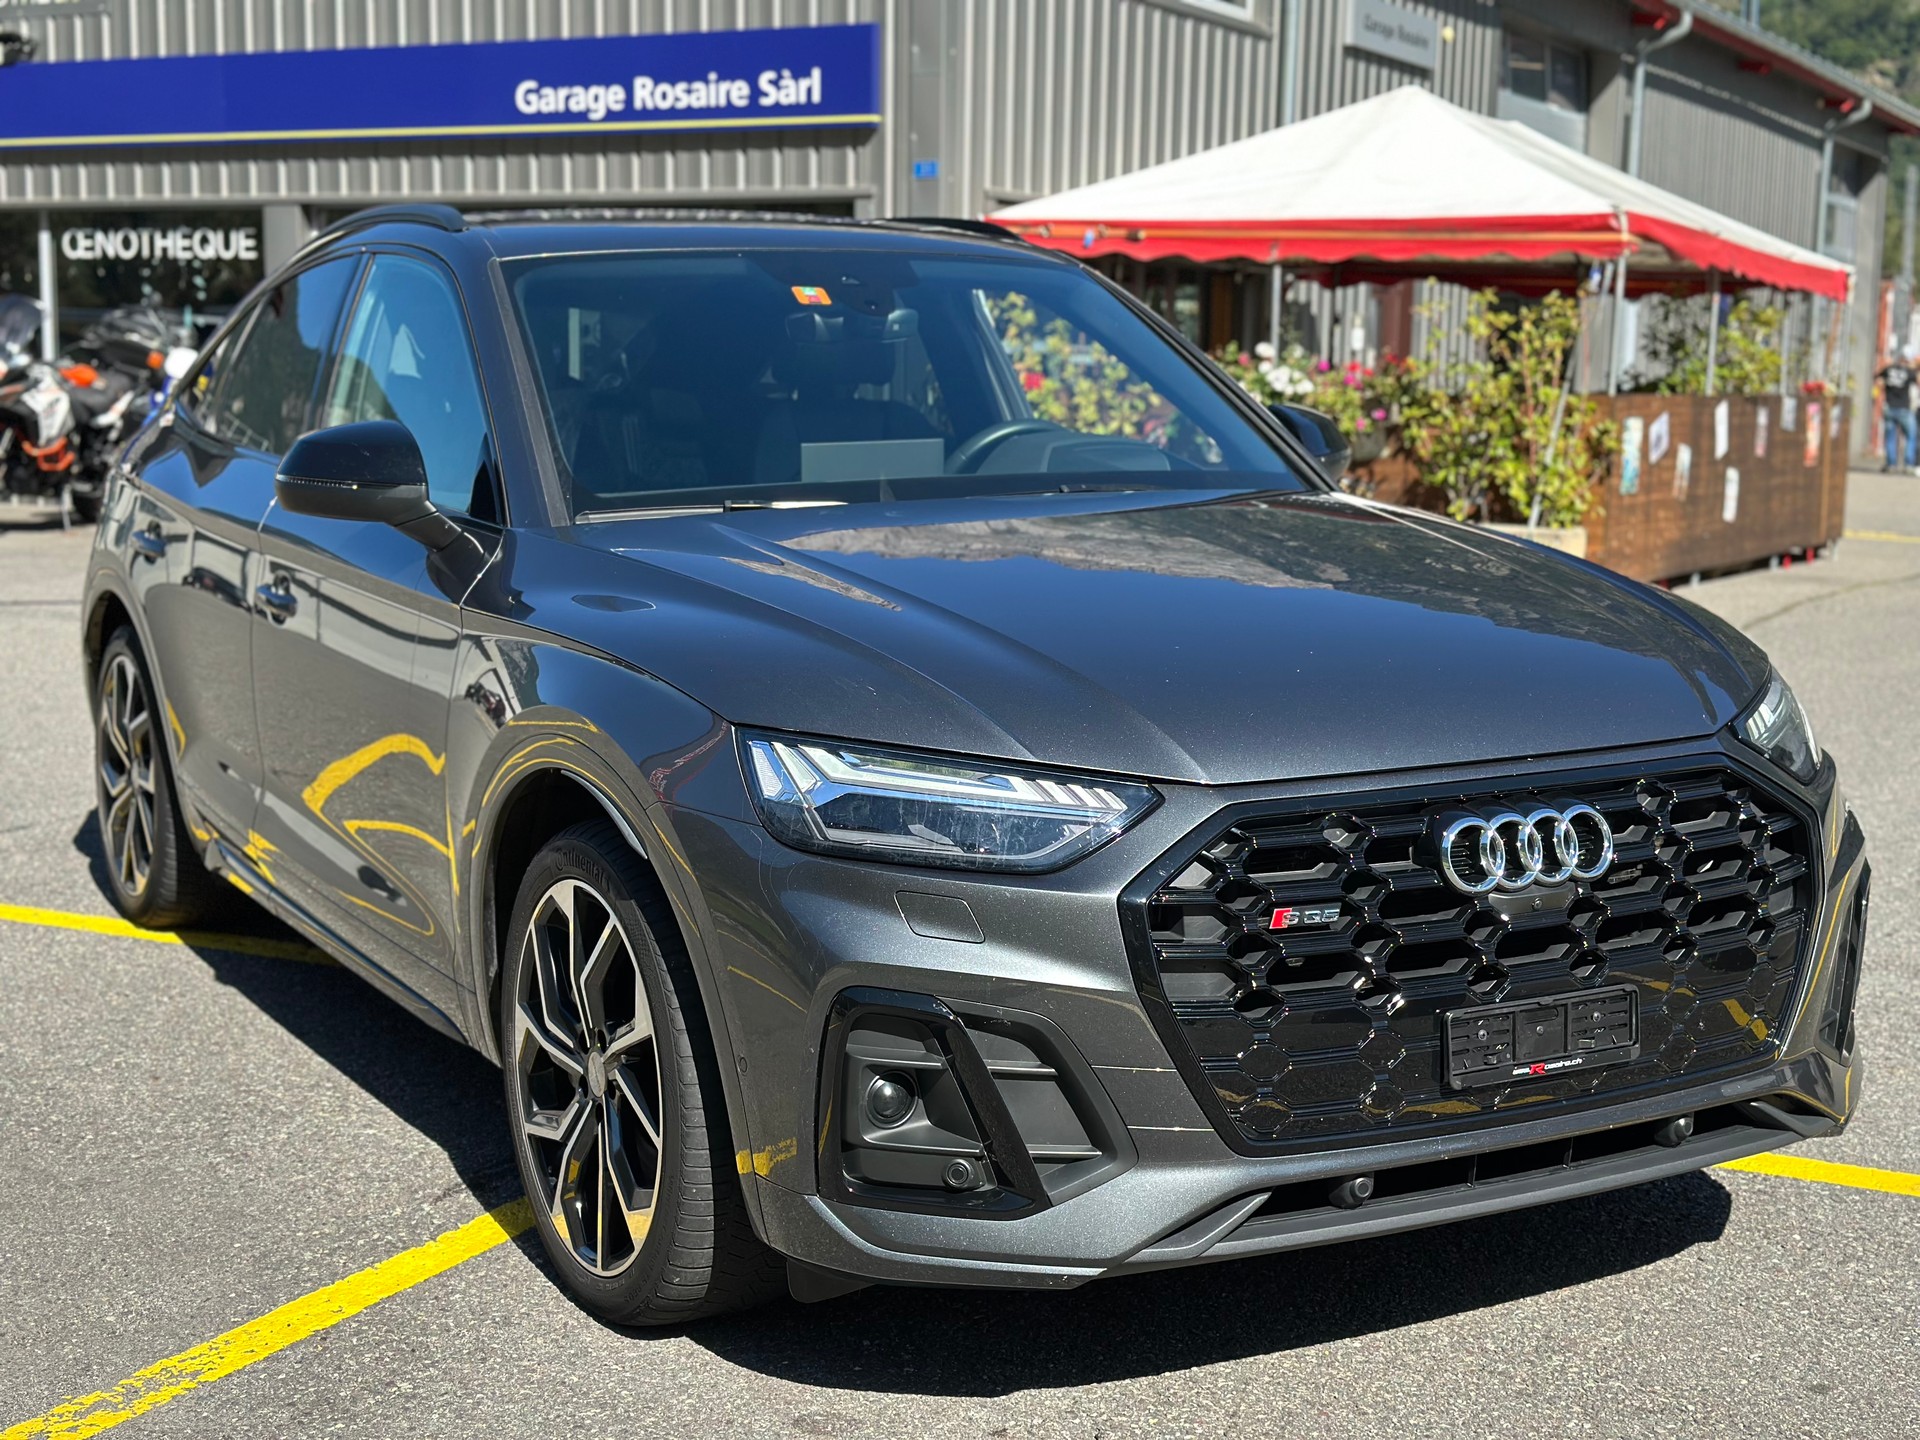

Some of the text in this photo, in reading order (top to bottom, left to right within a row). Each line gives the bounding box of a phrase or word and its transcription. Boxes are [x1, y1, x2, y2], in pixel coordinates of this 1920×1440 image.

[514, 66, 822, 121] Garage Rosaire Sàrl
[1277, 907, 1340, 928] SQ5
